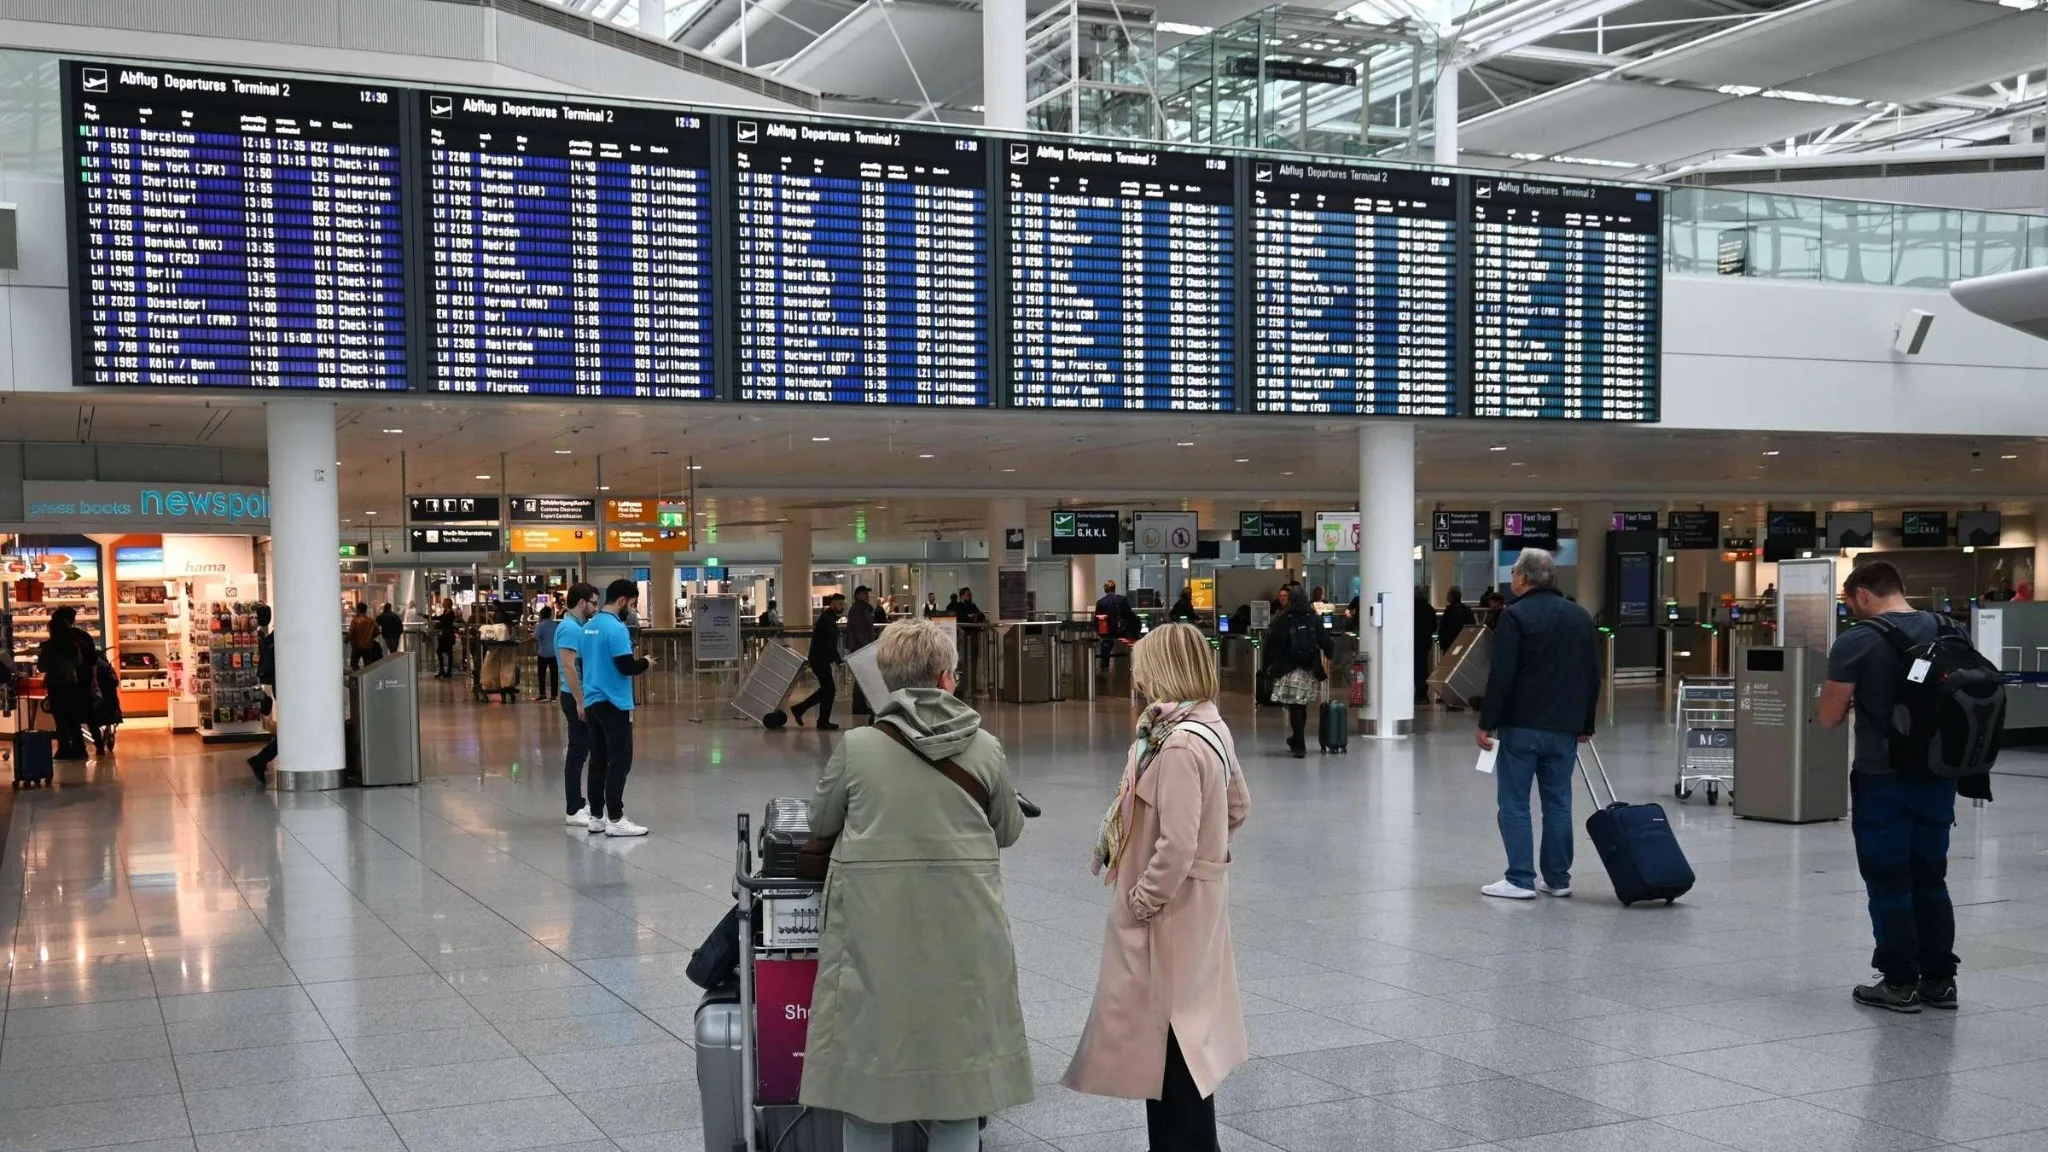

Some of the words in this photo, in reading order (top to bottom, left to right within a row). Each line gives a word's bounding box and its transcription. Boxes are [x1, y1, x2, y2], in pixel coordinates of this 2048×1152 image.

[120, 71, 158, 88] Abflug
[164, 74, 226, 93] Departures
[232, 80, 280, 95] Terminal
[282, 84, 290, 96] 2
[359, 91, 387, 104] 12:30
[463, 98, 496, 115] Abflug
[502, 101, 556, 119] Departures
[561, 106, 604, 122] Terminal
[606, 109, 613, 123] 2
[675, 116, 700, 128] 12:30
[85, 125, 98, 137] LH
[242, 136, 271, 149] 12:15
[276, 139, 305, 151] 12:35
[333, 143, 389, 157] aufgerufen
[766, 124, 796, 139] Abflug
[801, 126, 850, 143] Departures
[854, 131, 892, 146] Terminal
[894, 134, 900, 146] 2
[86, 140, 99, 152] TP
[242, 151, 272, 164] 12:50
[277, 153, 306, 166] 13:15
[333, 157, 378, 171] Check-in
[1037, 145, 1063, 160] Abflug
[1068, 147, 1111, 163] Departures
[1115, 151, 1149, 165] Terminal
[1151, 154, 1156, 165] 2
[86, 156, 99, 167] LH
[243, 166, 272, 178] 12:50
[334, 172, 390, 186] aufgerufen
[570, 159, 596, 171] 14:40
[1279, 165, 1303, 178] Abflug
[1307, 166, 1346, 180] Departures
[1350, 169, 1380, 181] Terminal
[1382, 171, 1386, 182] 2
[243, 181, 273, 193] 12:55
[1497, 181, 1519, 194] Abflug
[1523, 183, 1558, 197] Departures
[1562, 187, 1589, 198] Terminal
[1591, 189, 1595, 199] 2
[571, 188, 597, 199] 14:45
[244, 196, 273, 208] 13:05
[244, 211, 274, 223] 13:10
[245, 226, 275, 238] 13:15
[572, 230, 598, 241] 14:55
[246, 241, 275, 253] 13:35
[246, 256, 276, 268] 13:35
[247, 271, 276, 283] 13:45
[247, 286, 277, 297] 13:55
[248, 301, 277, 312] 14:00
[248, 316, 278, 327] 14:00
[249, 330, 278, 342] 14:10
[283, 332, 312, 343] 15:00
[249, 345, 279, 357] 14:10
[250, 360, 279, 371] 14:20
[95, 371, 108, 382] LH
[250, 375, 280, 386] 14:30
[341, 377, 386, 389] Check-in
[575, 384, 601, 395] 15:15
[29, 502, 75, 517] press
[80, 500, 132, 515] books
[1102, 528, 1107, 537] L
[185, 559, 227, 573] hama
